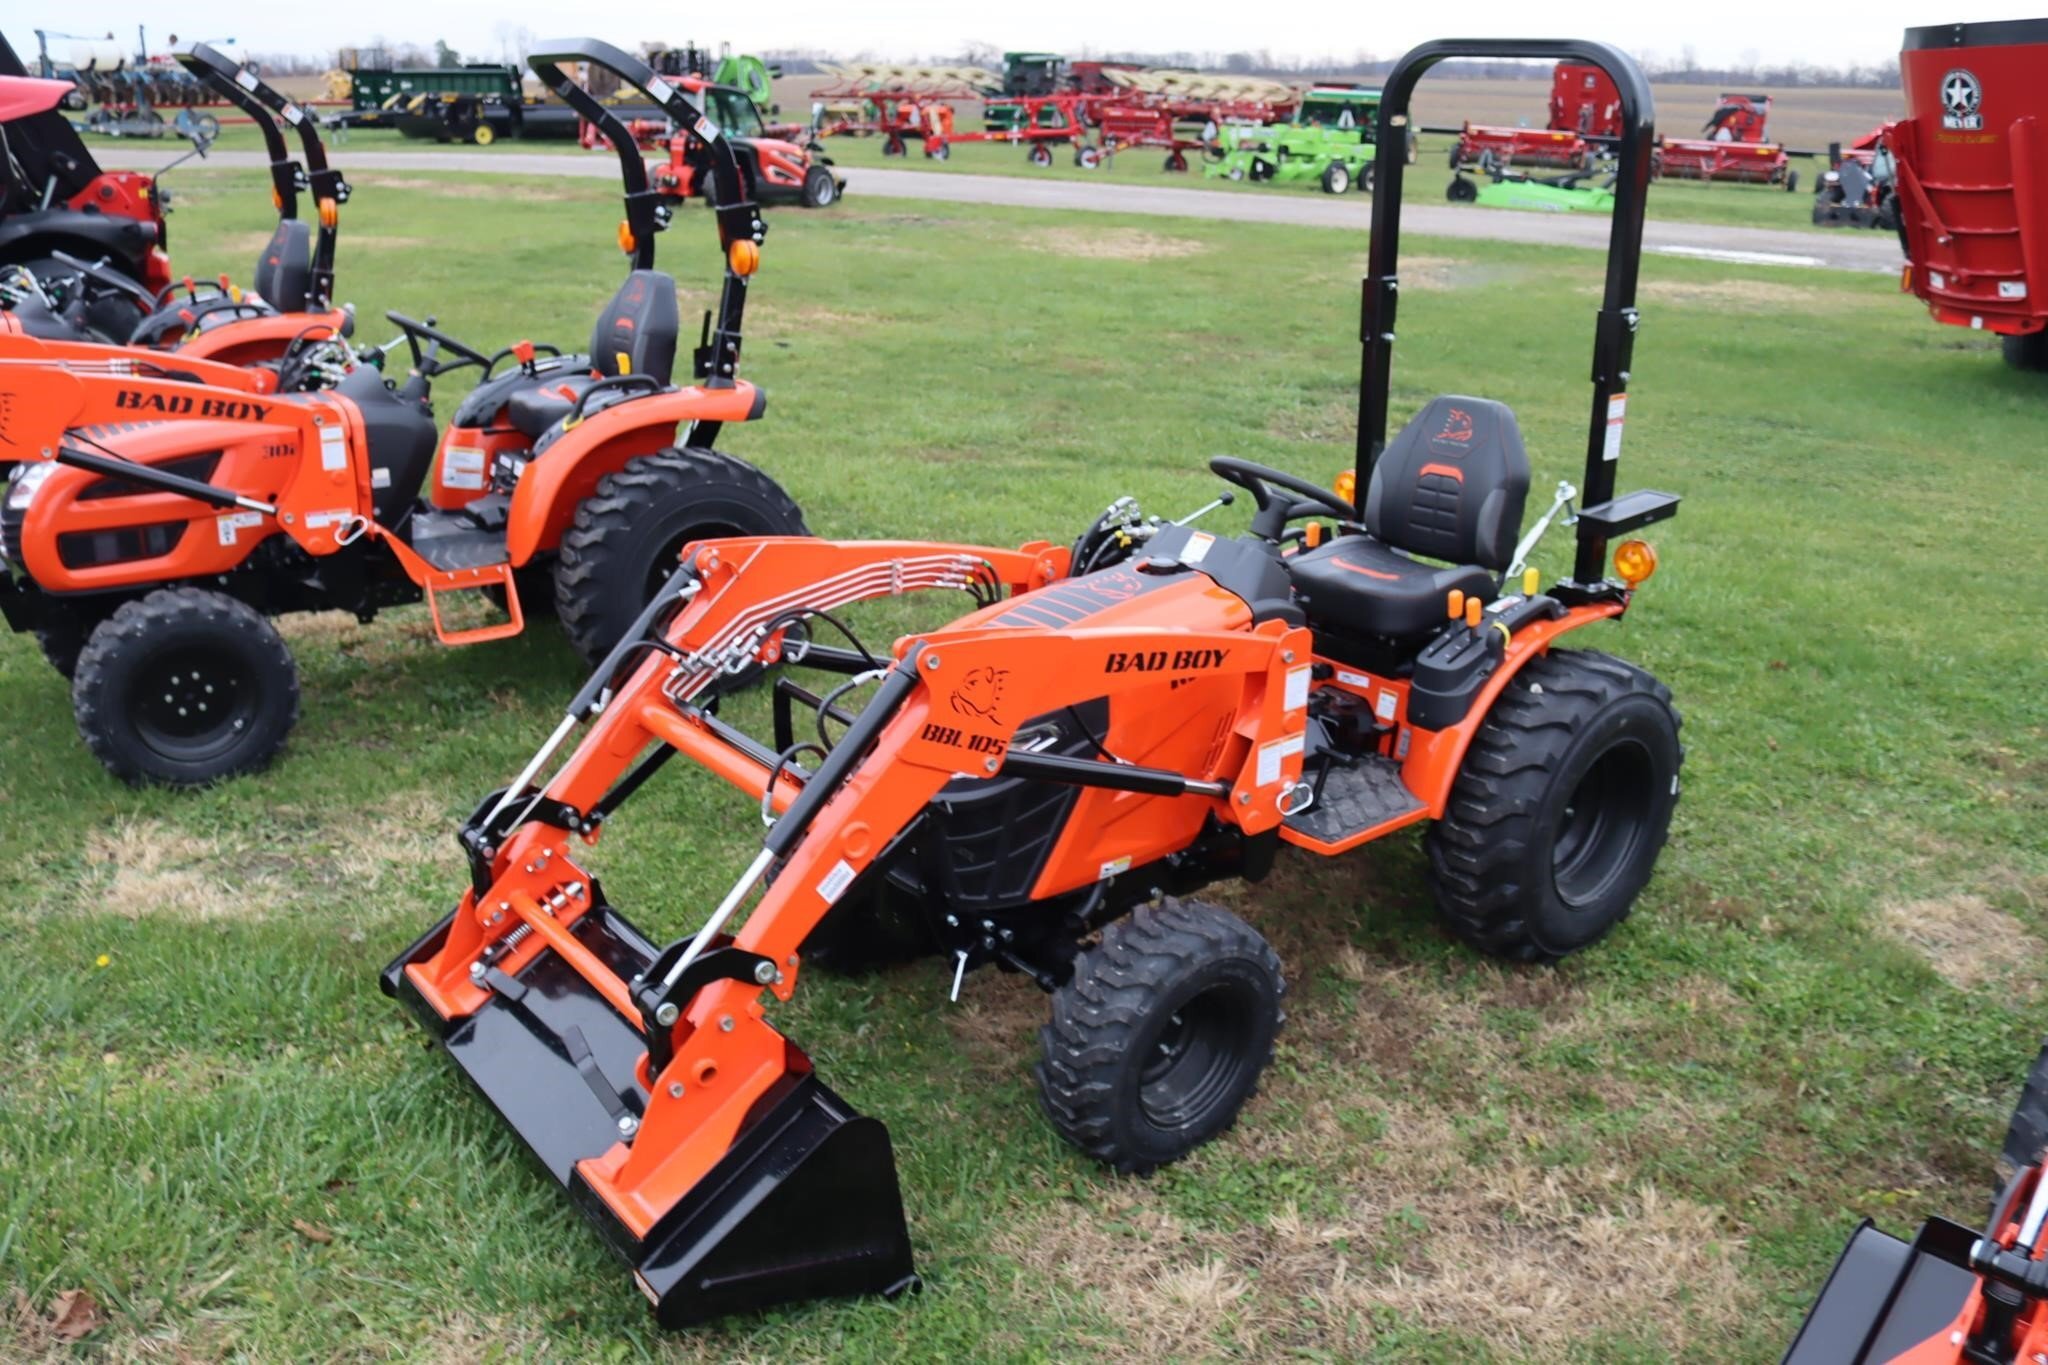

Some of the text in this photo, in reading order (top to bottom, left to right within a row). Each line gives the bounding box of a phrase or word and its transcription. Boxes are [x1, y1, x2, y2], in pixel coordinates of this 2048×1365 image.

[115, 390, 274, 421] BAD BOY
[1105, 649, 1230, 673] BAD BOY
[921, 723, 1007, 755] BBL 105
